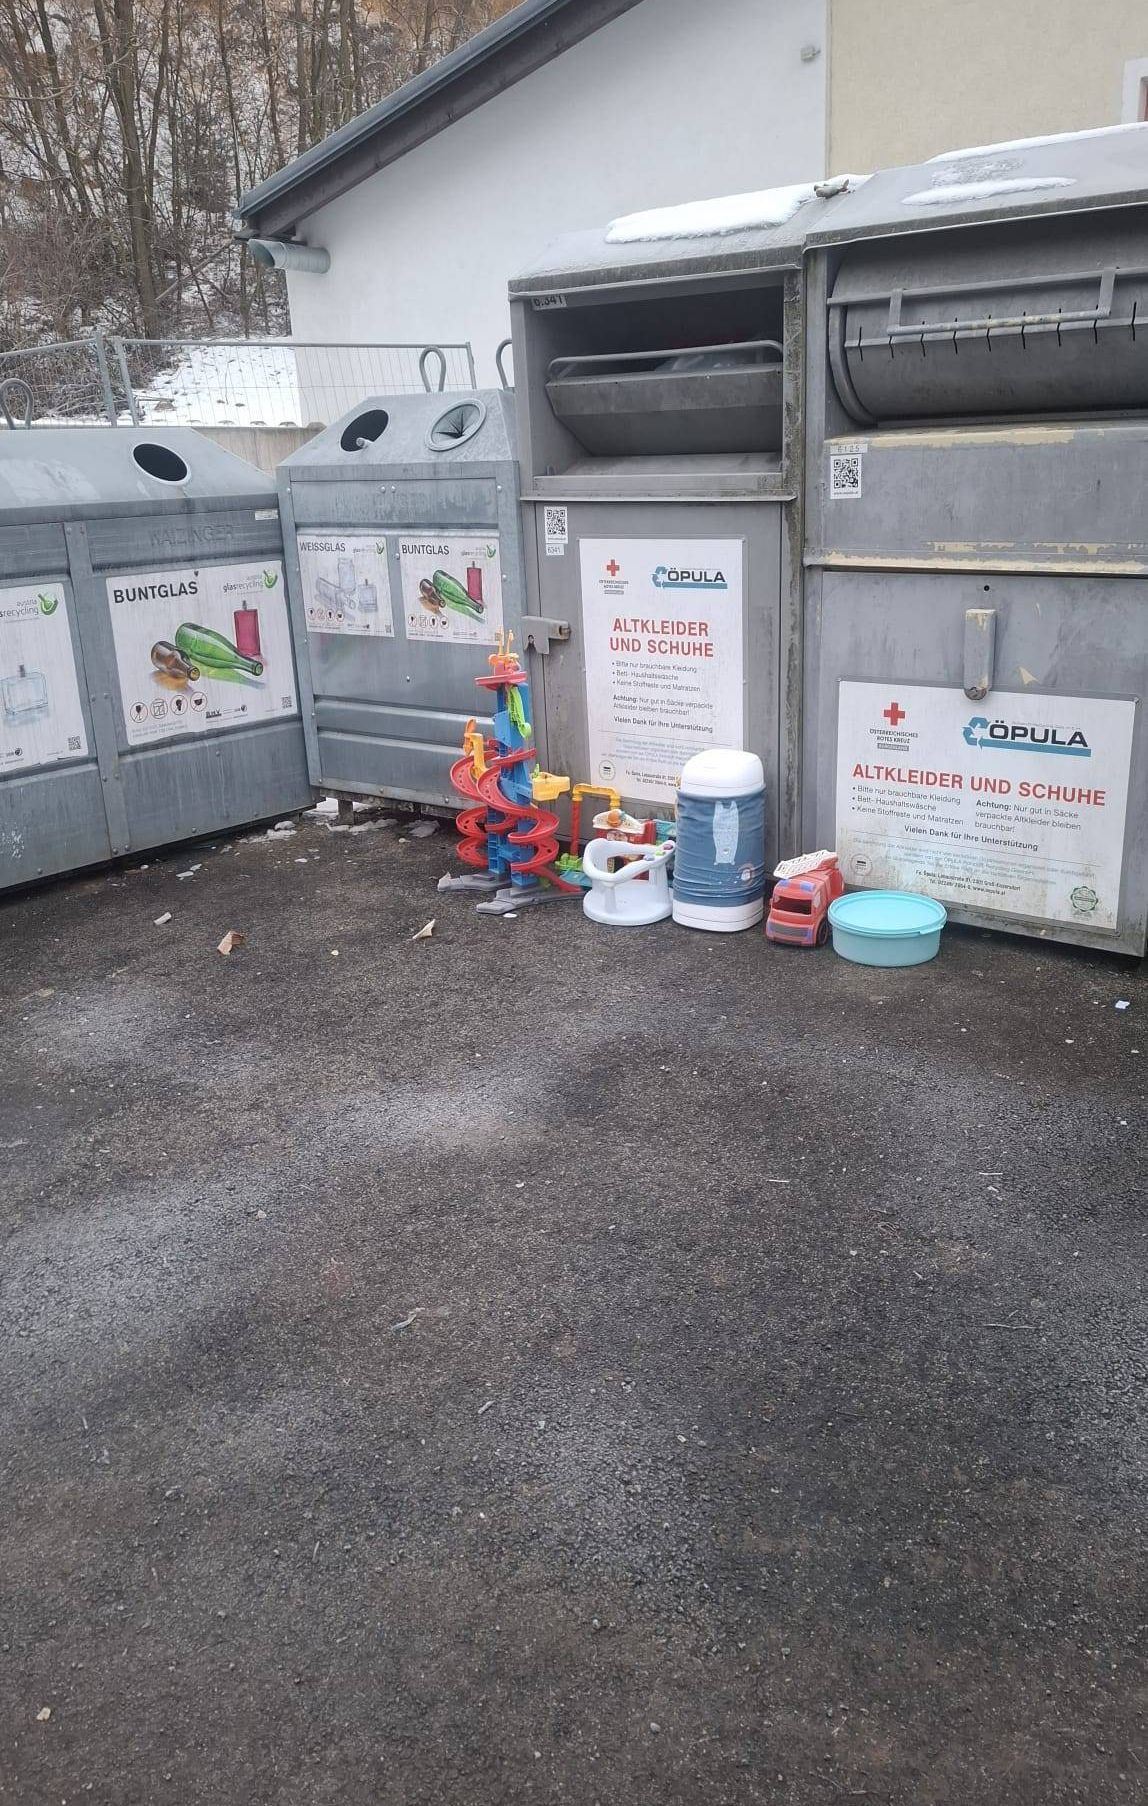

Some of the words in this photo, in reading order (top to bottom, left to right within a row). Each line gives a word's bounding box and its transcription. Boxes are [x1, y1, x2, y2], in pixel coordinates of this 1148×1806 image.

[300, 542, 346, 552] WEISSGLAS
[401, 544, 450, 555] BUNTGLAS
[667, 567, 726, 583] ÖPULA
[113, 581, 199, 604] BUNTGLAS
[613, 617, 709, 637] ALTKLEIDER
[609, 637, 642, 652] UND
[647, 639, 714, 658] SCHUHE
[640, 662, 671, 671] brauchbare
[672, 665, 697, 673] Kleidung
[672, 684, 701, 692] Matratzen
[613, 694, 638, 703] Achtung:
[650, 698, 661, 706] gut
[685, 701, 713, 710] verpackte
[659, 707, 690, 716] brauchbar!
[613, 716, 632, 724] Vielen
[632, 717, 647, 725] Dank
[648, 719, 657, 727] für
[658, 720, 670, 728] Ihre
[670, 721, 713, 733] Unterstützung
[989, 719, 1089, 748] ÖPULA
[852, 763, 963, 790] ALTKLEIDER
[970, 775, 1011, 795] UND
[1018, 781, 1107, 806] SCHUHE
[857, 785, 873, 793] Bitte
[887, 790, 928, 800] brauchbare
[929, 793, 961, 806] Kleidung
[875, 798, 937, 812] Haushaltswäsche
[976, 799, 1012, 812] Achtung:
[1029, 807, 1042, 816] gut
[1044, 808, 1052, 816] in
[1053, 808, 1079, 819] Säcke
[856, 806, 876, 814] Keine
[877, 807, 911, 819] Stoffreste
[912, 812, 926, 821] und
[927, 814, 964, 826] Matratzen
[975, 811, 1013, 822] verpackte
[1014, 815, 1051, 827] Altkleider
[1051, 820, 1081, 831] bleiben
[974, 821, 1015, 833] brauchbar!
[904, 825, 928, 835] Vielen
[929, 828, 949, 839] Dank
[950, 831, 962, 840] für
[963, 834, 979, 842] Ihre
[981, 835, 1039, 852] Unterstützung
